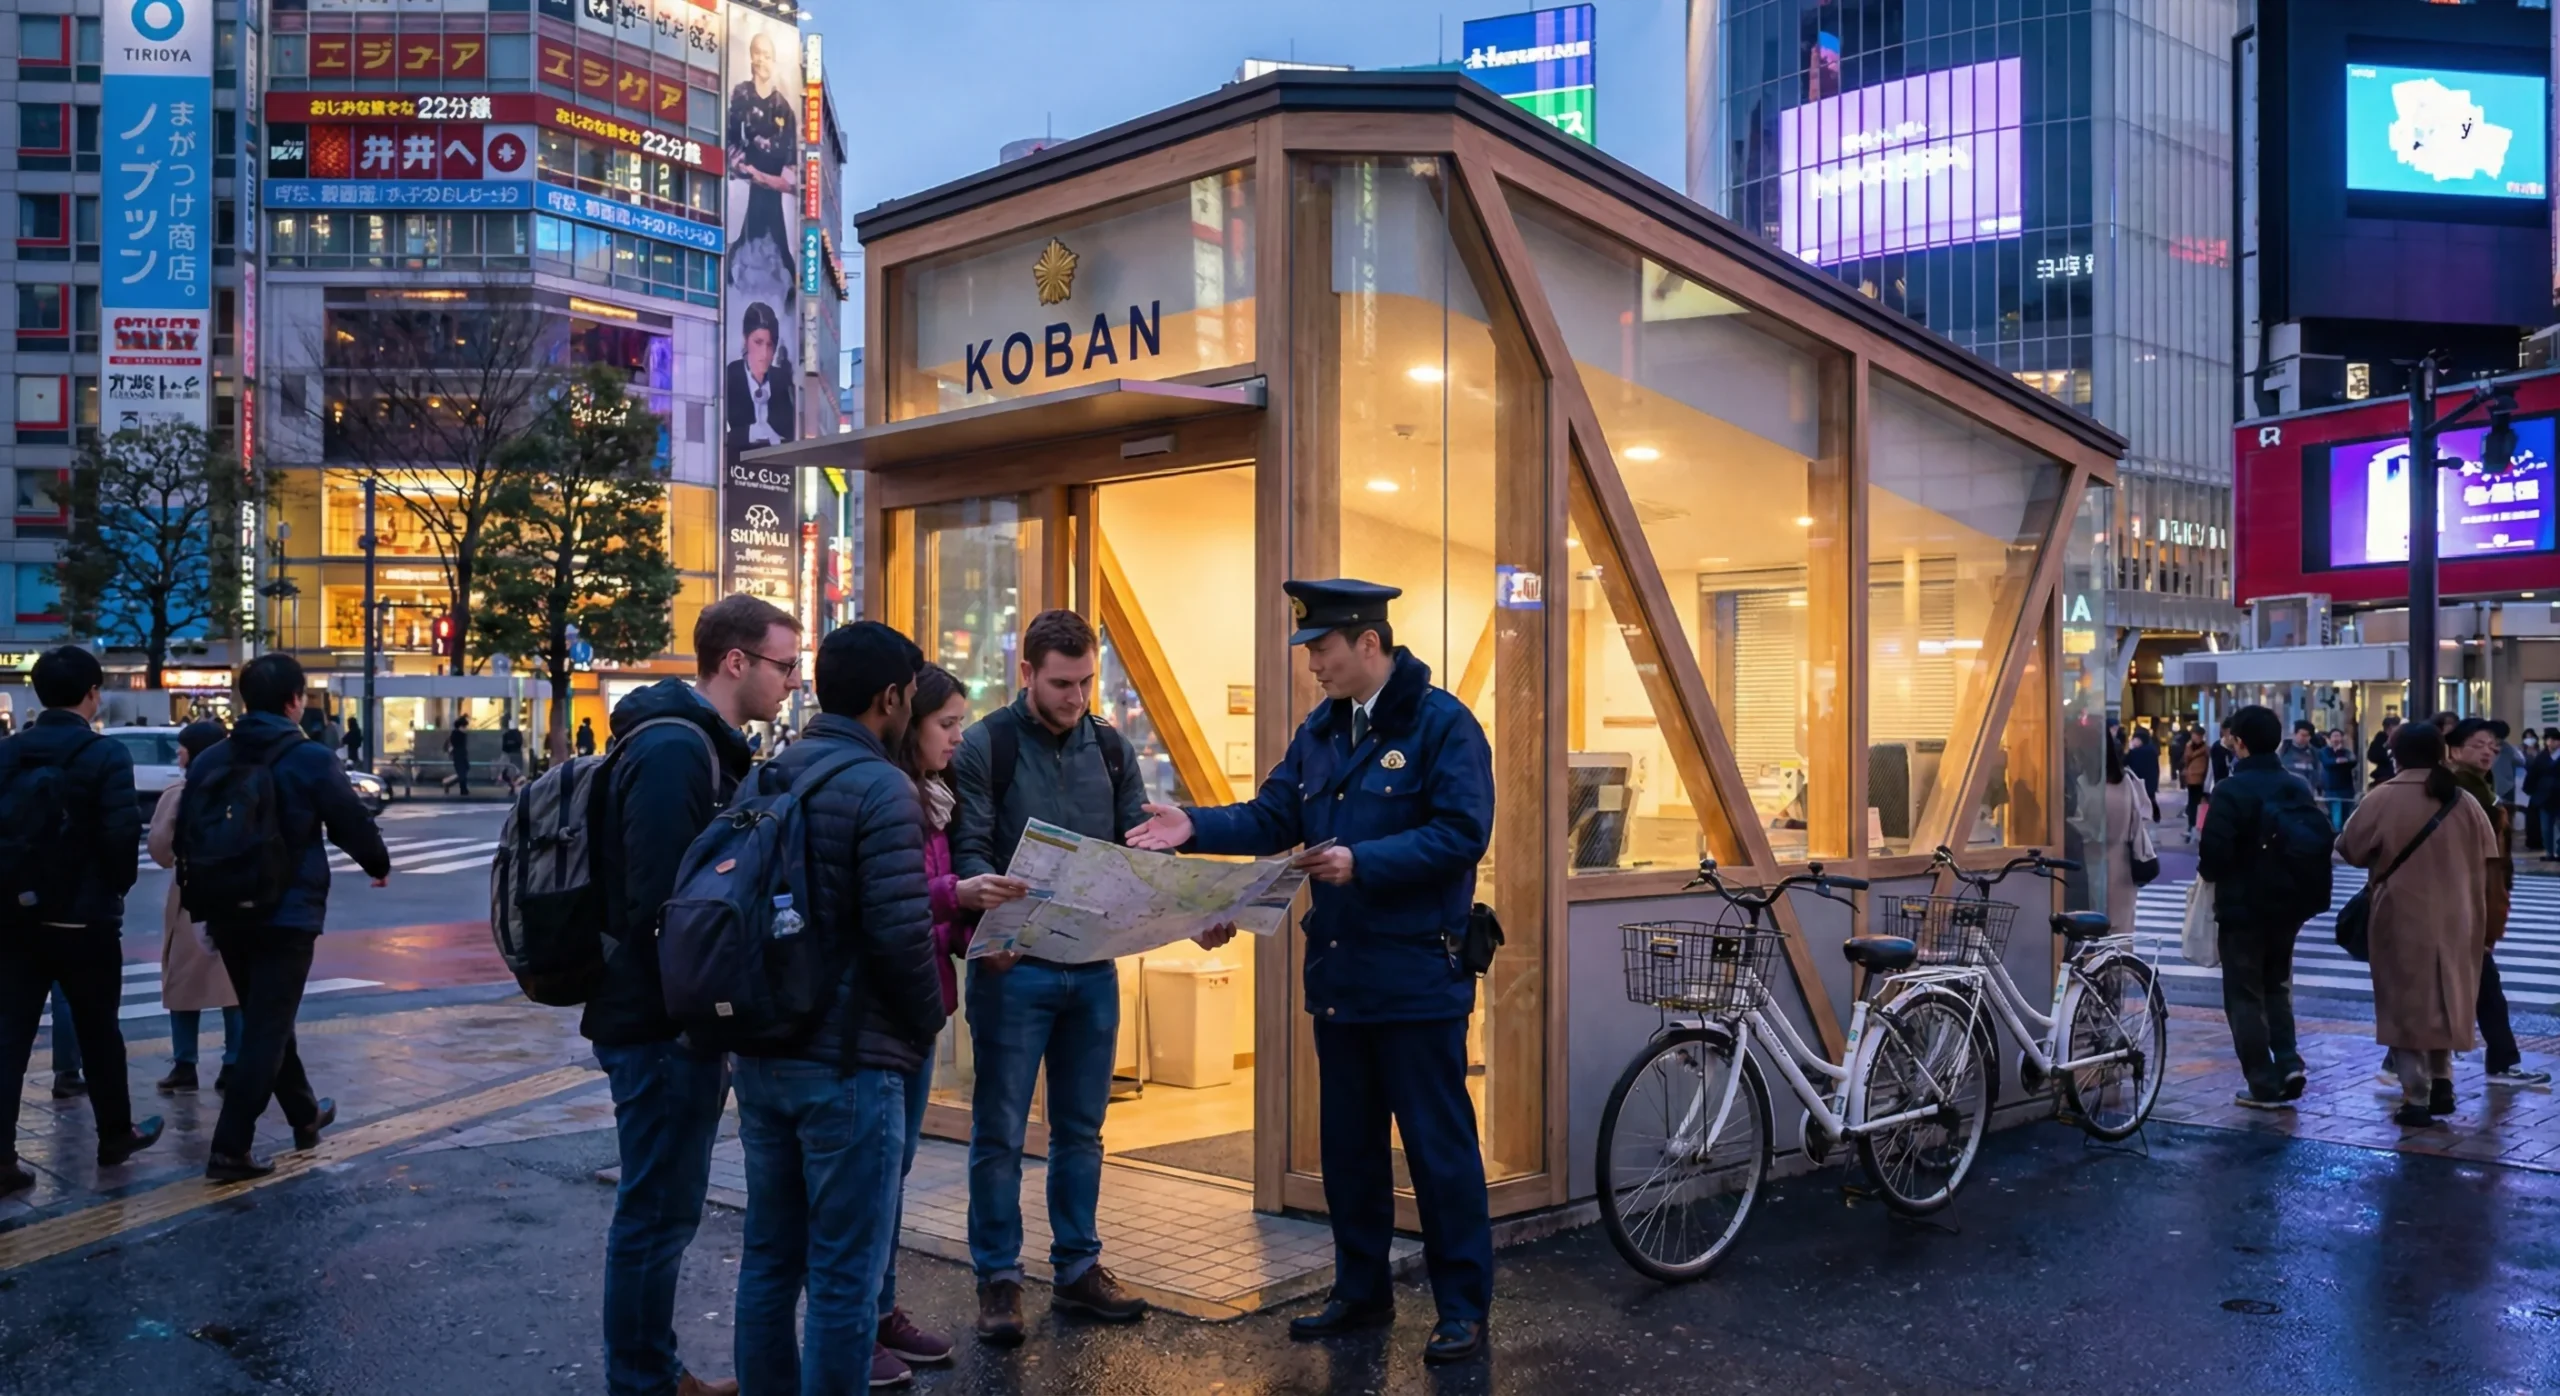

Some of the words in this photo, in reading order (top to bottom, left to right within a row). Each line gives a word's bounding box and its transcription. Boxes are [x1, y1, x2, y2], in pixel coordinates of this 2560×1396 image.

[123, 47, 192, 62] TIRIOYA
[168, 102, 196, 296] まがつけ商店。
[965, 300, 1161, 394] KOBAN
